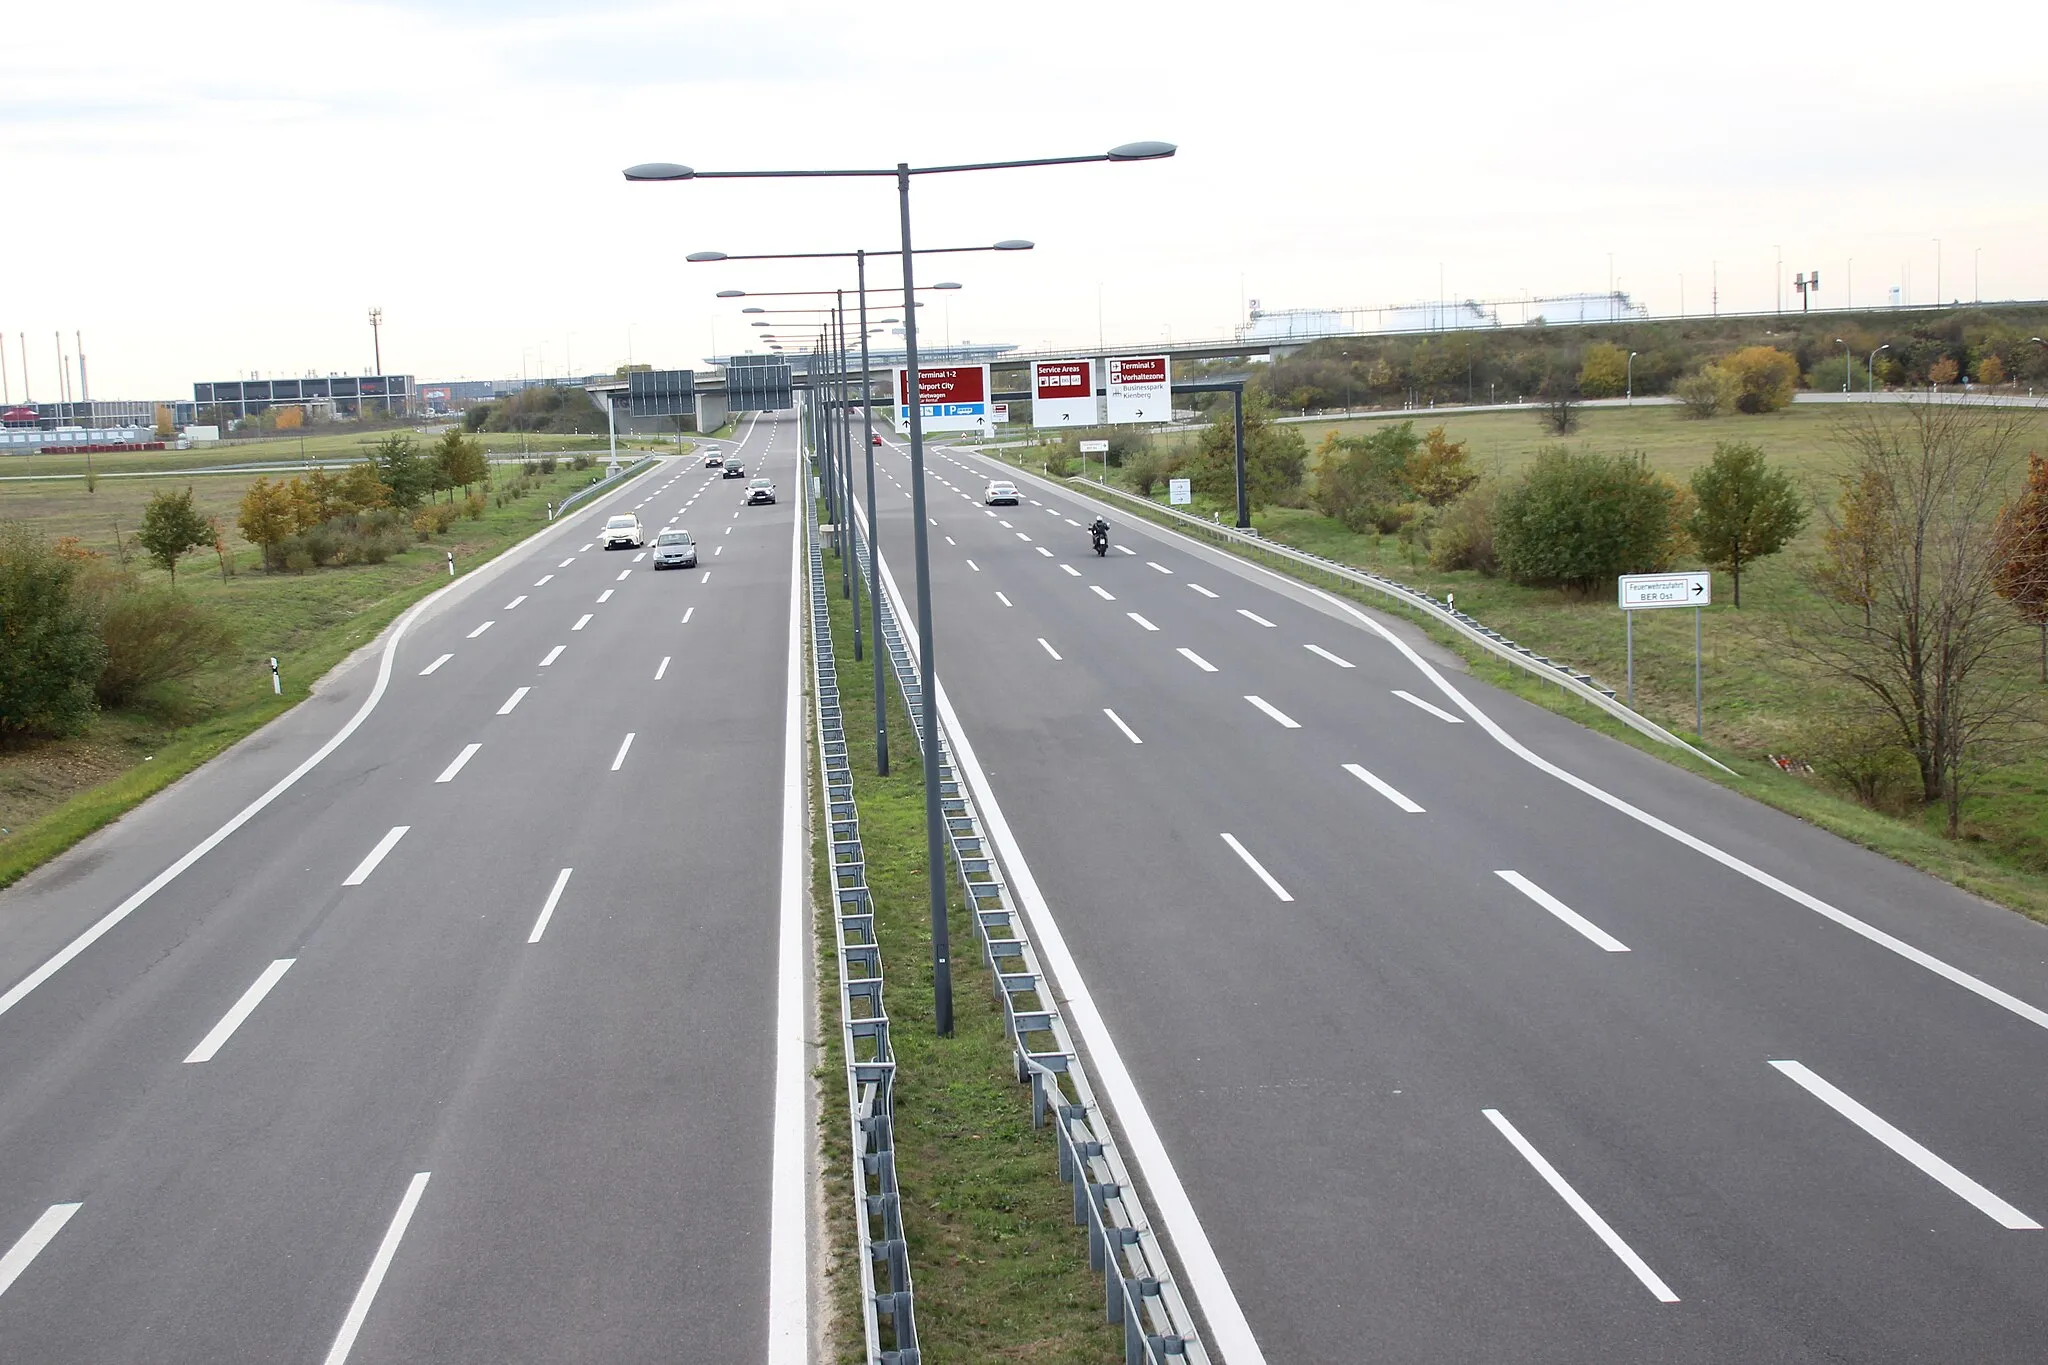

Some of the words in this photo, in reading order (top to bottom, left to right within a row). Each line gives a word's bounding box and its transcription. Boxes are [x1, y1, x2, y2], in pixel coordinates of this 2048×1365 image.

[1062, 365, 1080, 373] Areas
[918, 371, 945, 379] Terminal
[946, 370, 957, 378] 1-2
[1122, 373, 1164, 381] Vorhaltezone
[919, 383, 940, 391] Airport
[941, 382, 954, 390] City
[1123, 384, 1163, 392] Businesspark
[1629, 582, 1684, 591] Feuerwehrzufahrt
[1640, 593, 1657, 601] BER
[1659, 592, 1673, 600] Ost
